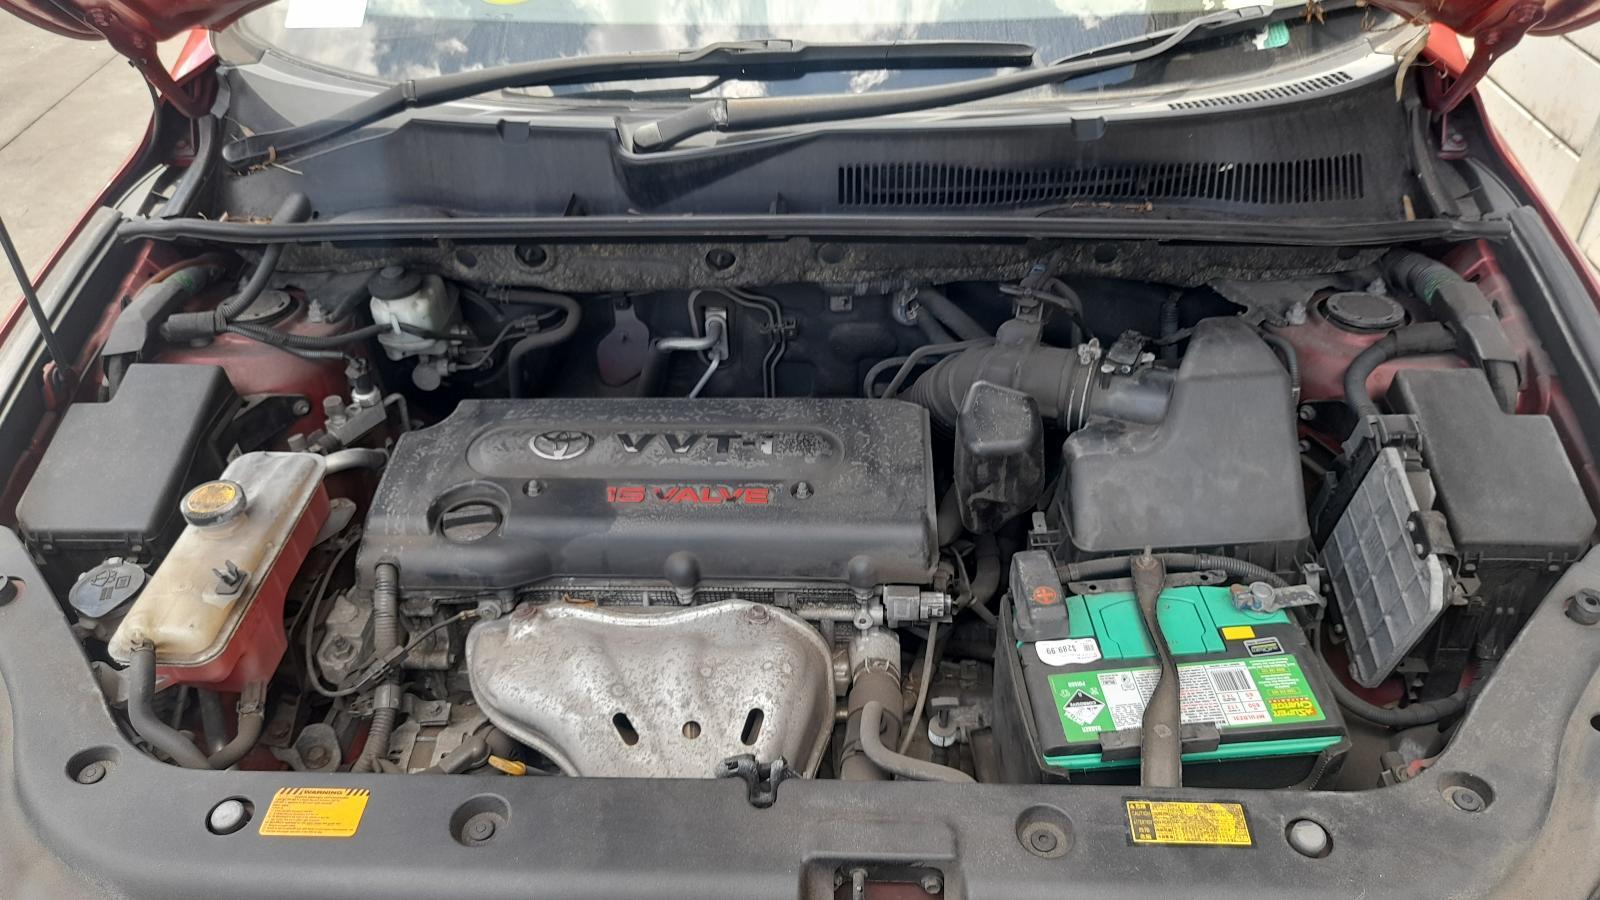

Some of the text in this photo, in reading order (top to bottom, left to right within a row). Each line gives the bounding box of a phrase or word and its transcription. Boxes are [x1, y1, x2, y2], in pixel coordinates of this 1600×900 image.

[617, 433, 774, 455] VVT-i
[608, 486, 769, 504] 16 VALVE
